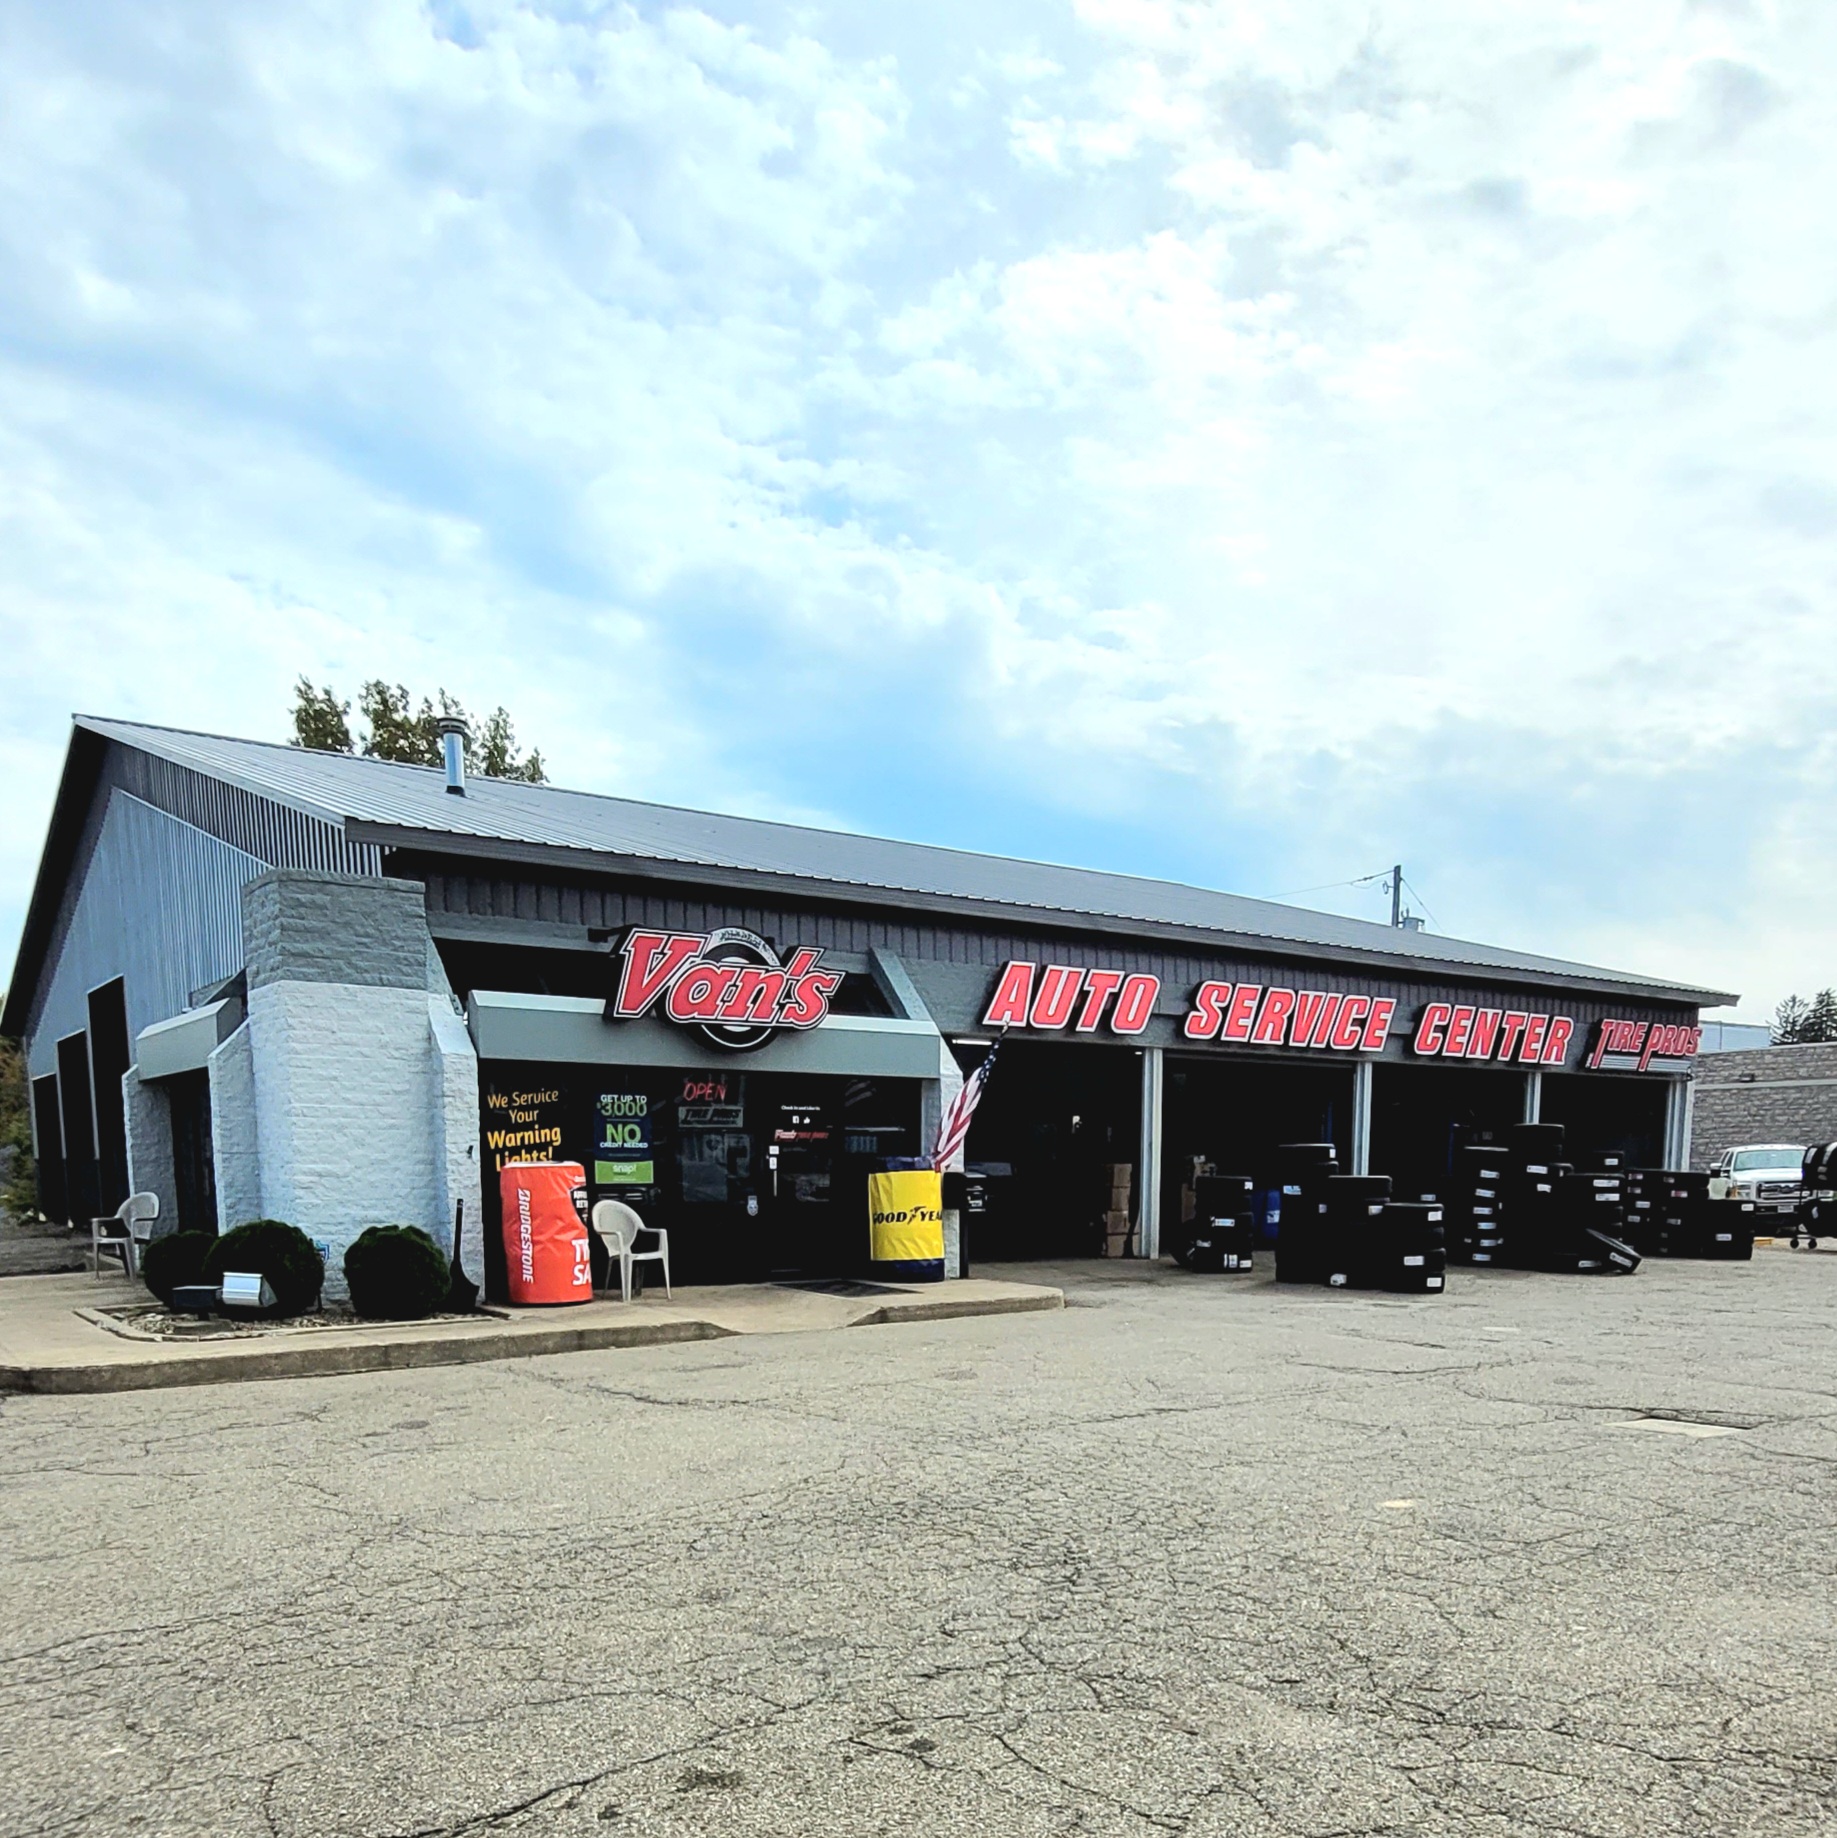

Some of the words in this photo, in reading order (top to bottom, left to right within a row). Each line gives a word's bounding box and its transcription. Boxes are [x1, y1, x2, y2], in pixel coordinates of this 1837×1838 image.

[614, 928, 846, 1030] Van's
[982, 960, 1161, 1035] AUTO
[1184, 980, 1397, 1052] SERVICE
[1414, 1002, 1575, 1066] CENTER
[1590, 1018, 1649, 1069] TIRE
[1638, 1023, 1703, 1072] PROS
[487, 1094, 508, 1109] We
[511, 1088, 559, 1107] Service
[600, 1094, 619, 1103] GET
[621, 1095, 633, 1103] UP
[635, 1095, 647, 1104] TO
[683, 1082, 728, 1102] OPEN
[508, 1109, 539, 1124] Your
[487, 1124, 562, 1149] Warning
[606, 1123, 642, 1144] NO
[517, 1188, 534, 1285] BRIDGESTONE
